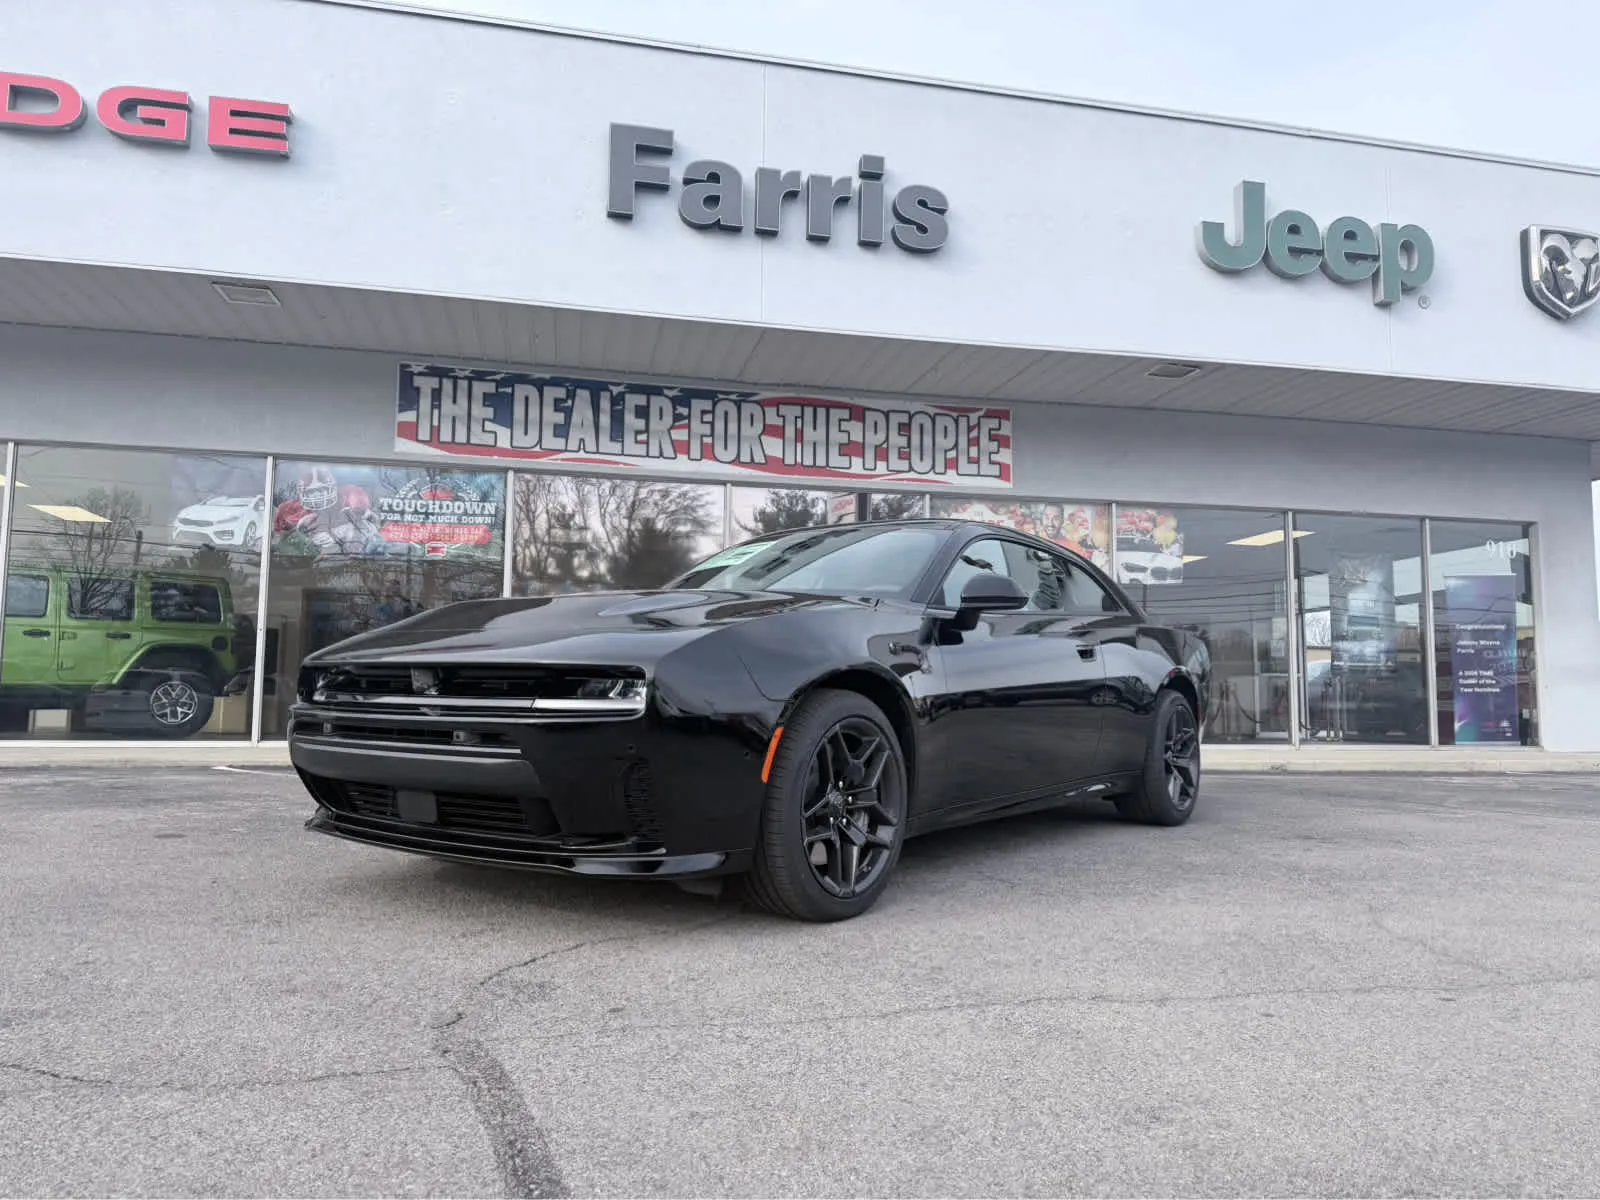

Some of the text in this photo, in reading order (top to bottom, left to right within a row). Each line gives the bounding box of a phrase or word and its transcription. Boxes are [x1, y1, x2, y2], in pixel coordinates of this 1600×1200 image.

[607, 122, 950, 253] Farris
[1199, 179, 1435, 306] Jeep
[412, 375, 1002, 477] THE DEALER FOR THE PEOPLE
[380, 498, 497, 514] TOUCHDOWN
[380, 512, 400, 521] FOR
[403, 514, 425, 523] NOT
[428, 515, 459, 523] MUCH
